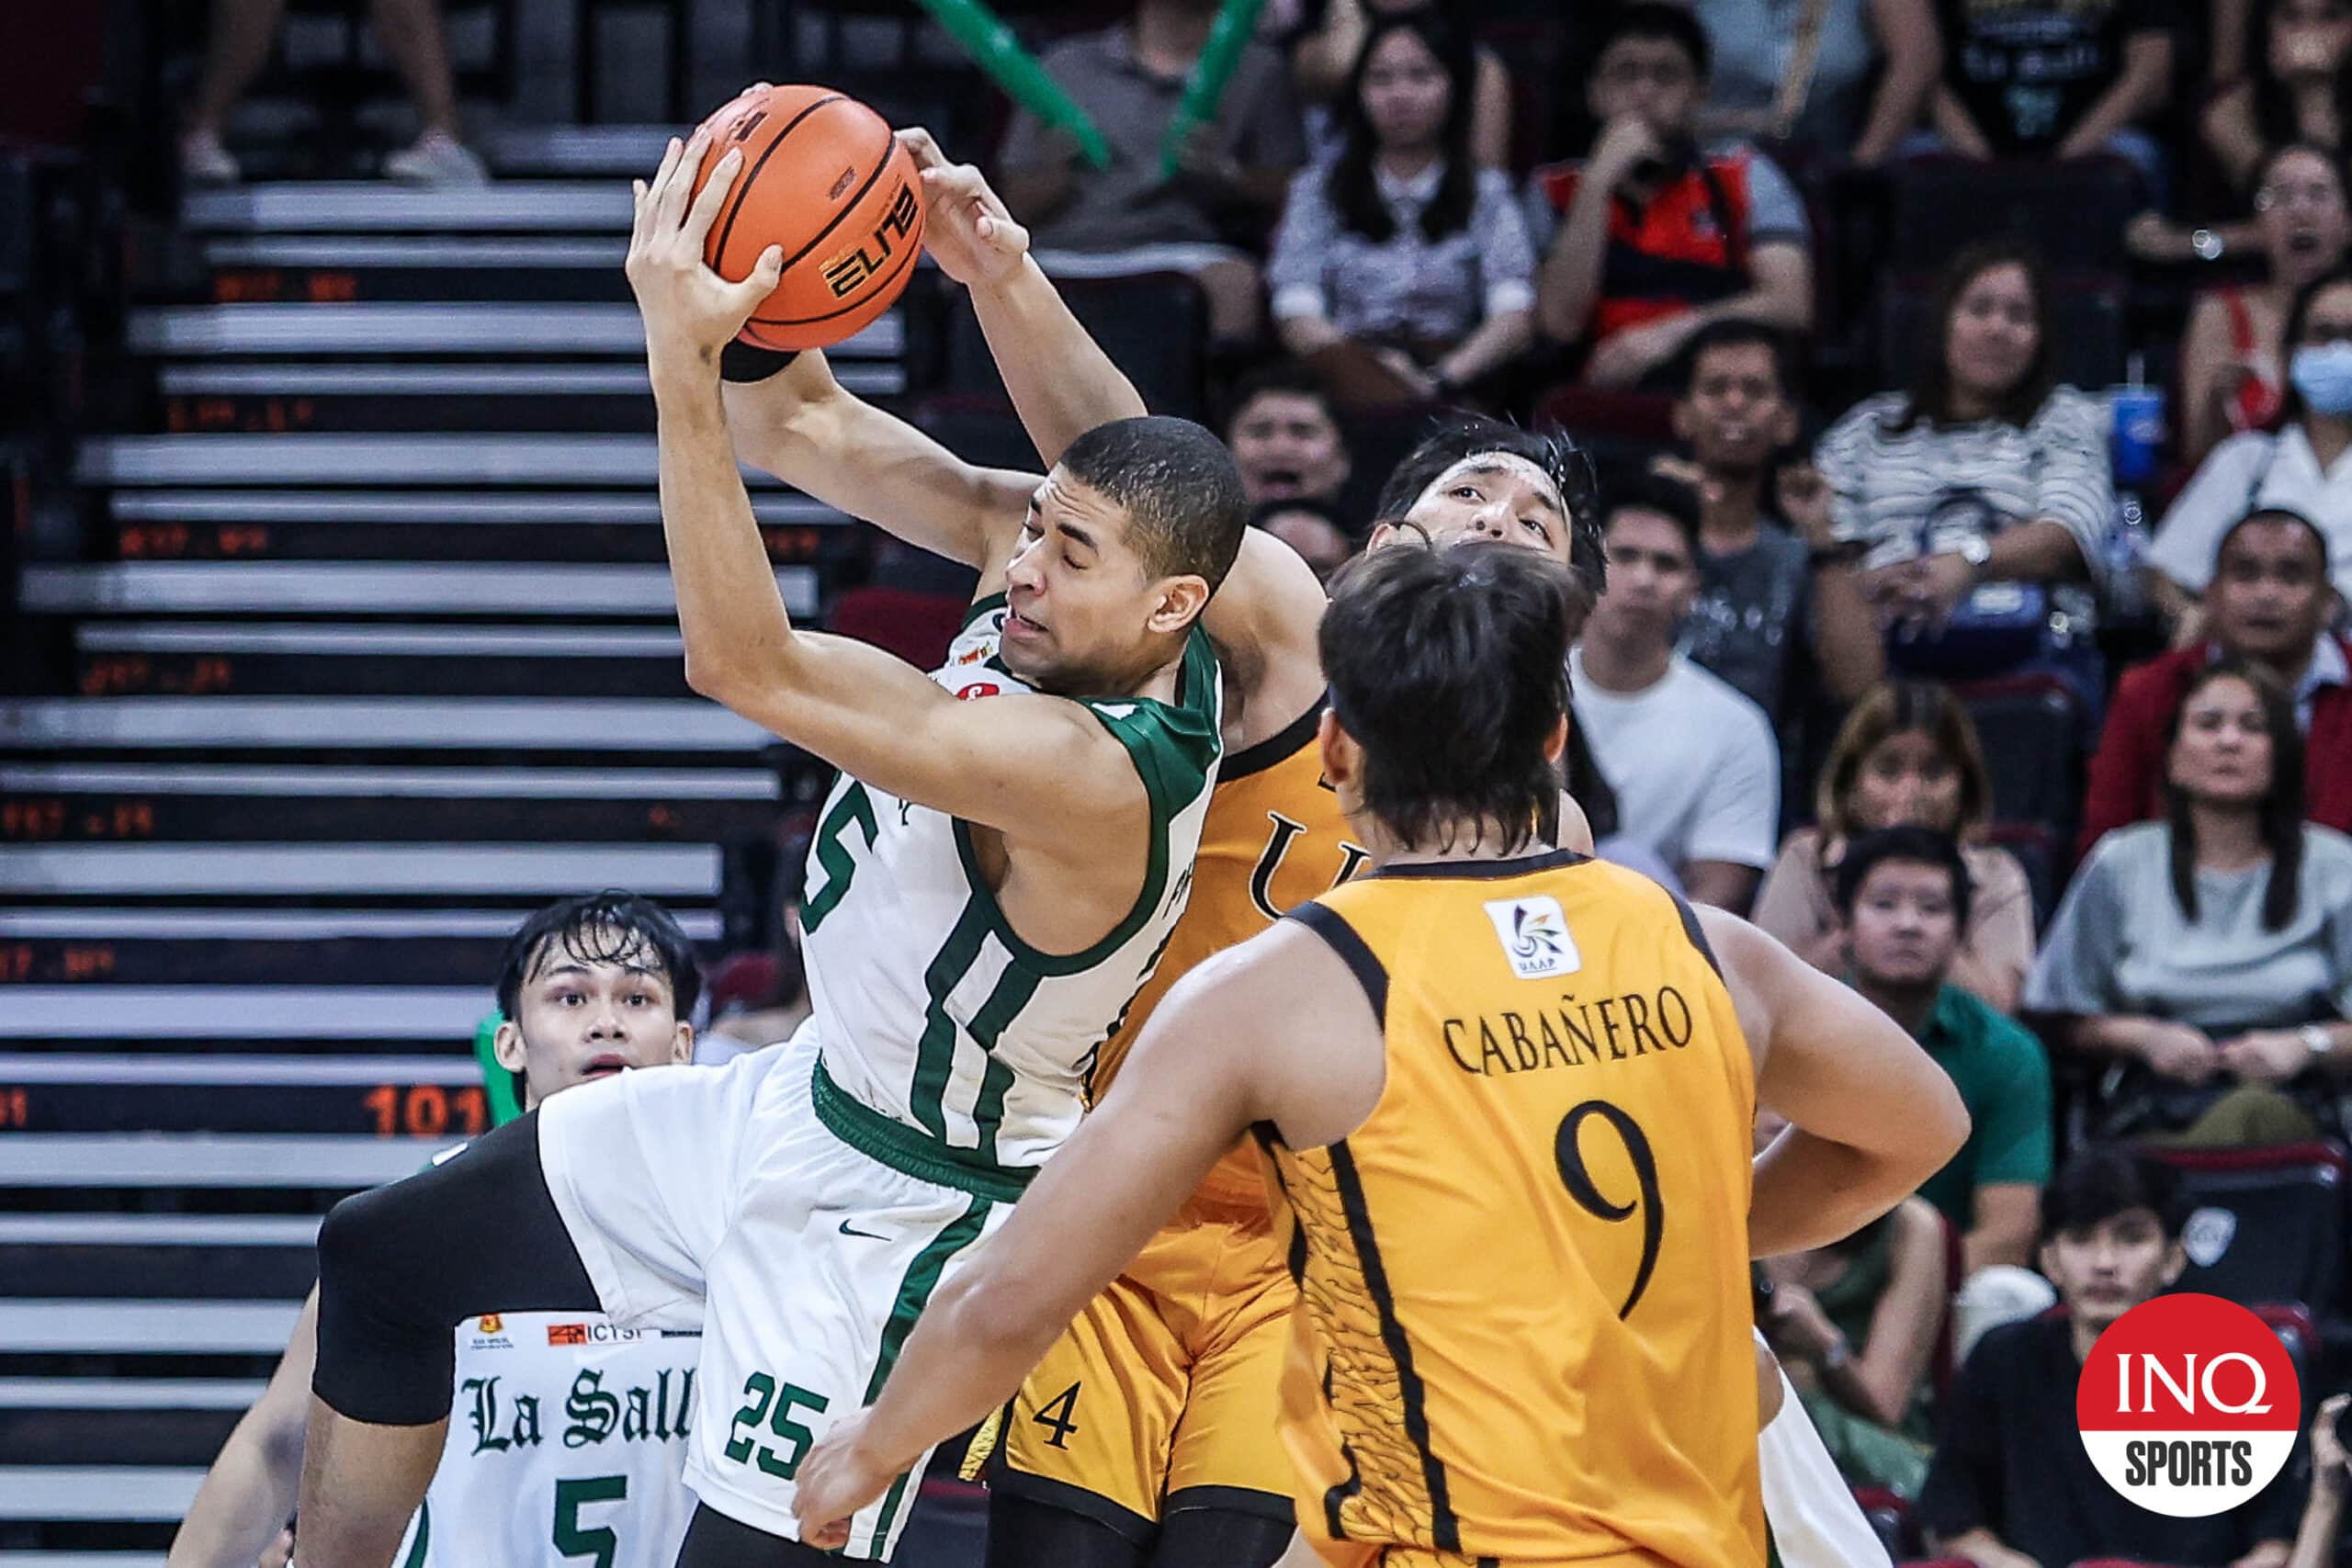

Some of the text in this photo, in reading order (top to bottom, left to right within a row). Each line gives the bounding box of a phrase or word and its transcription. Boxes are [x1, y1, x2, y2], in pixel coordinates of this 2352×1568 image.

[820, 182, 919, 299] ELITE
[1519, 957, 1556, 971] UAAP
[1443, 986, 1692, 1077] CABAÑERO
[365, 1084, 485, 1139] 101
[1555, 1100, 1664, 1321] 9
[461, 1376, 544, 1457] La
[724, 1371, 830, 1481] 25
[1033, 1381, 1081, 1450] 4
[553, 1475, 628, 1568] 5
